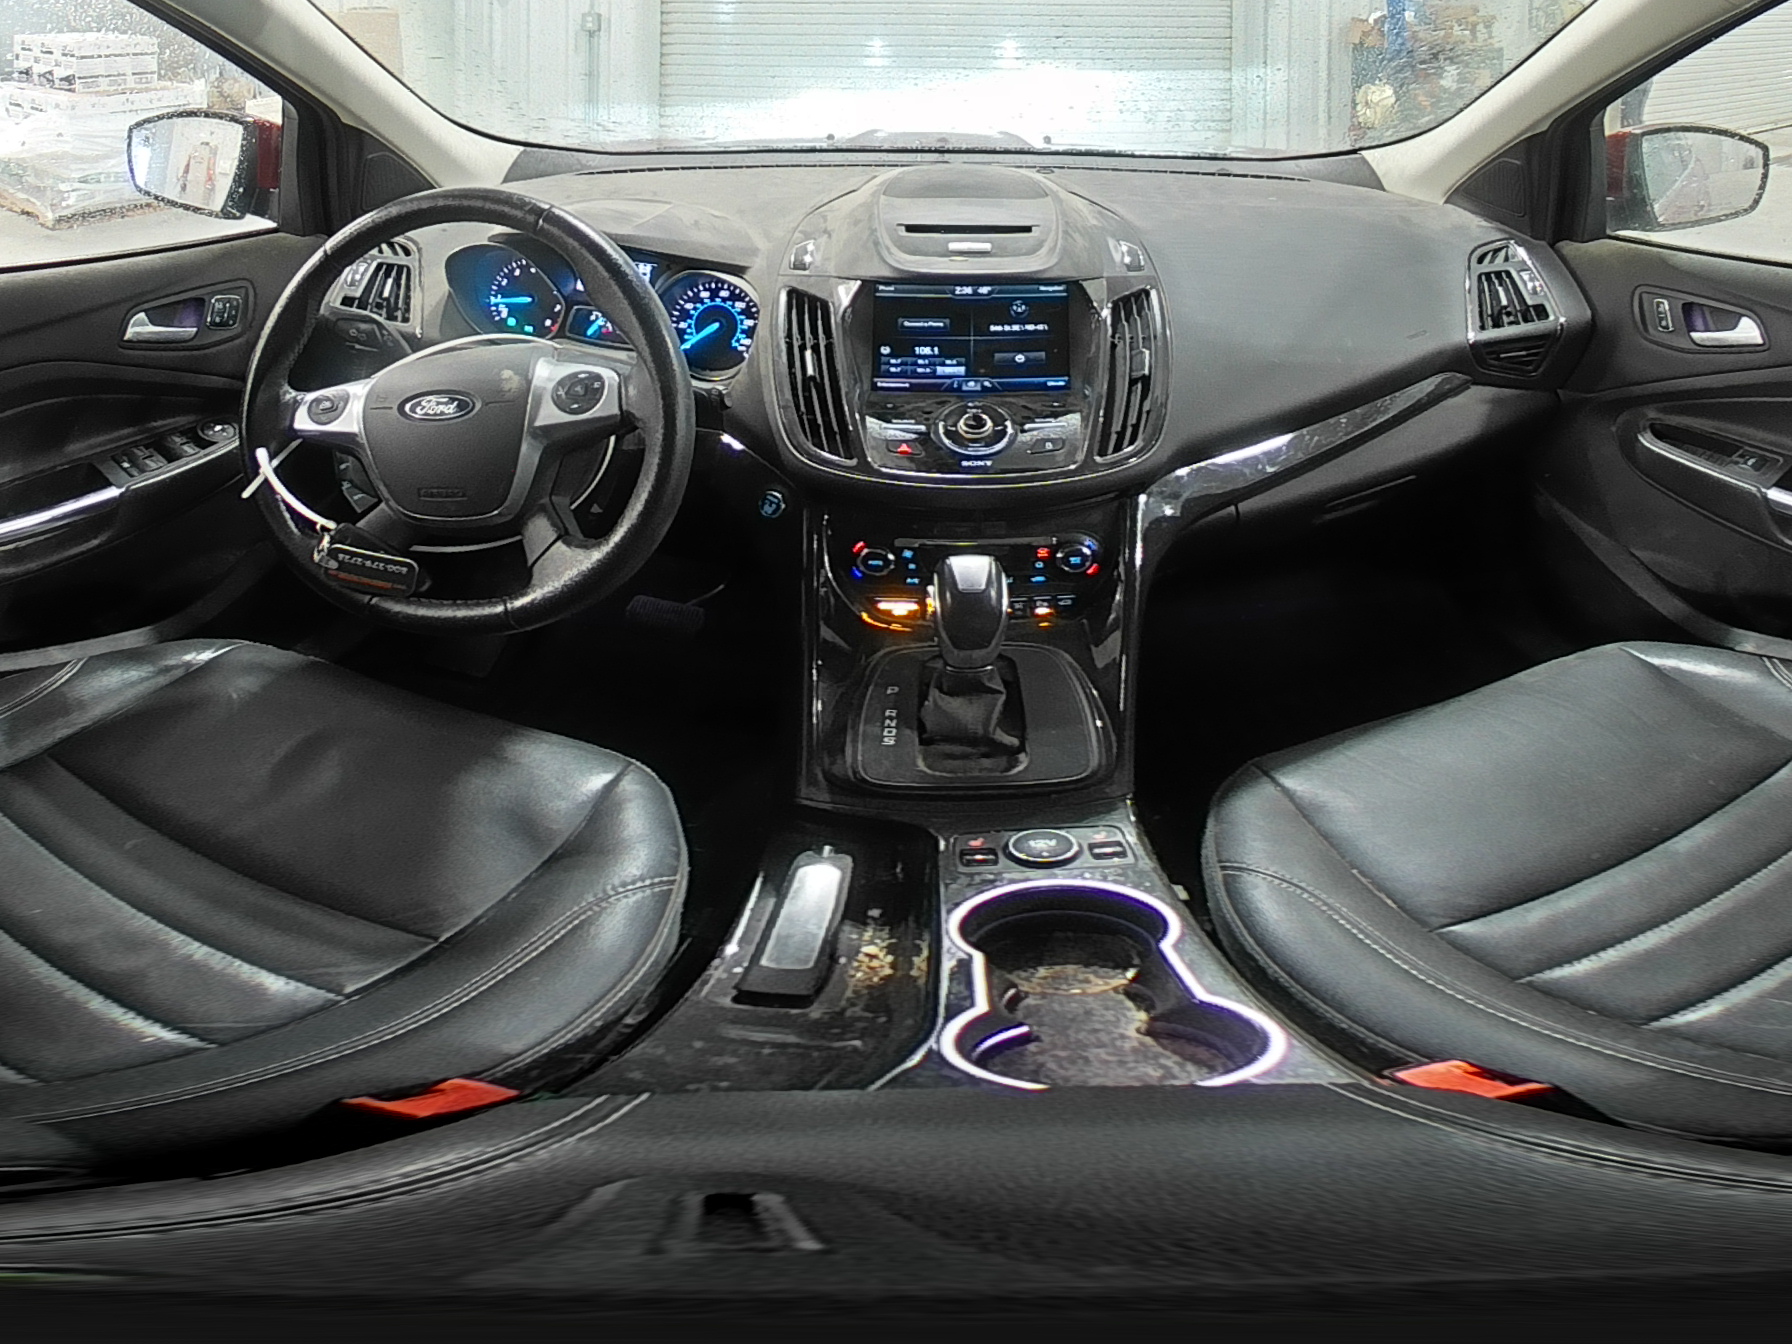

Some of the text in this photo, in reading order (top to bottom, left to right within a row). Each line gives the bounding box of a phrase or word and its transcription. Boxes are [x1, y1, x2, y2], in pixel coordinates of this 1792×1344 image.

[415, 398, 459, 415] Ford
[886, 686, 899, 695] P
[884, 718, 898, 727] N
[882, 727, 898, 736] D
